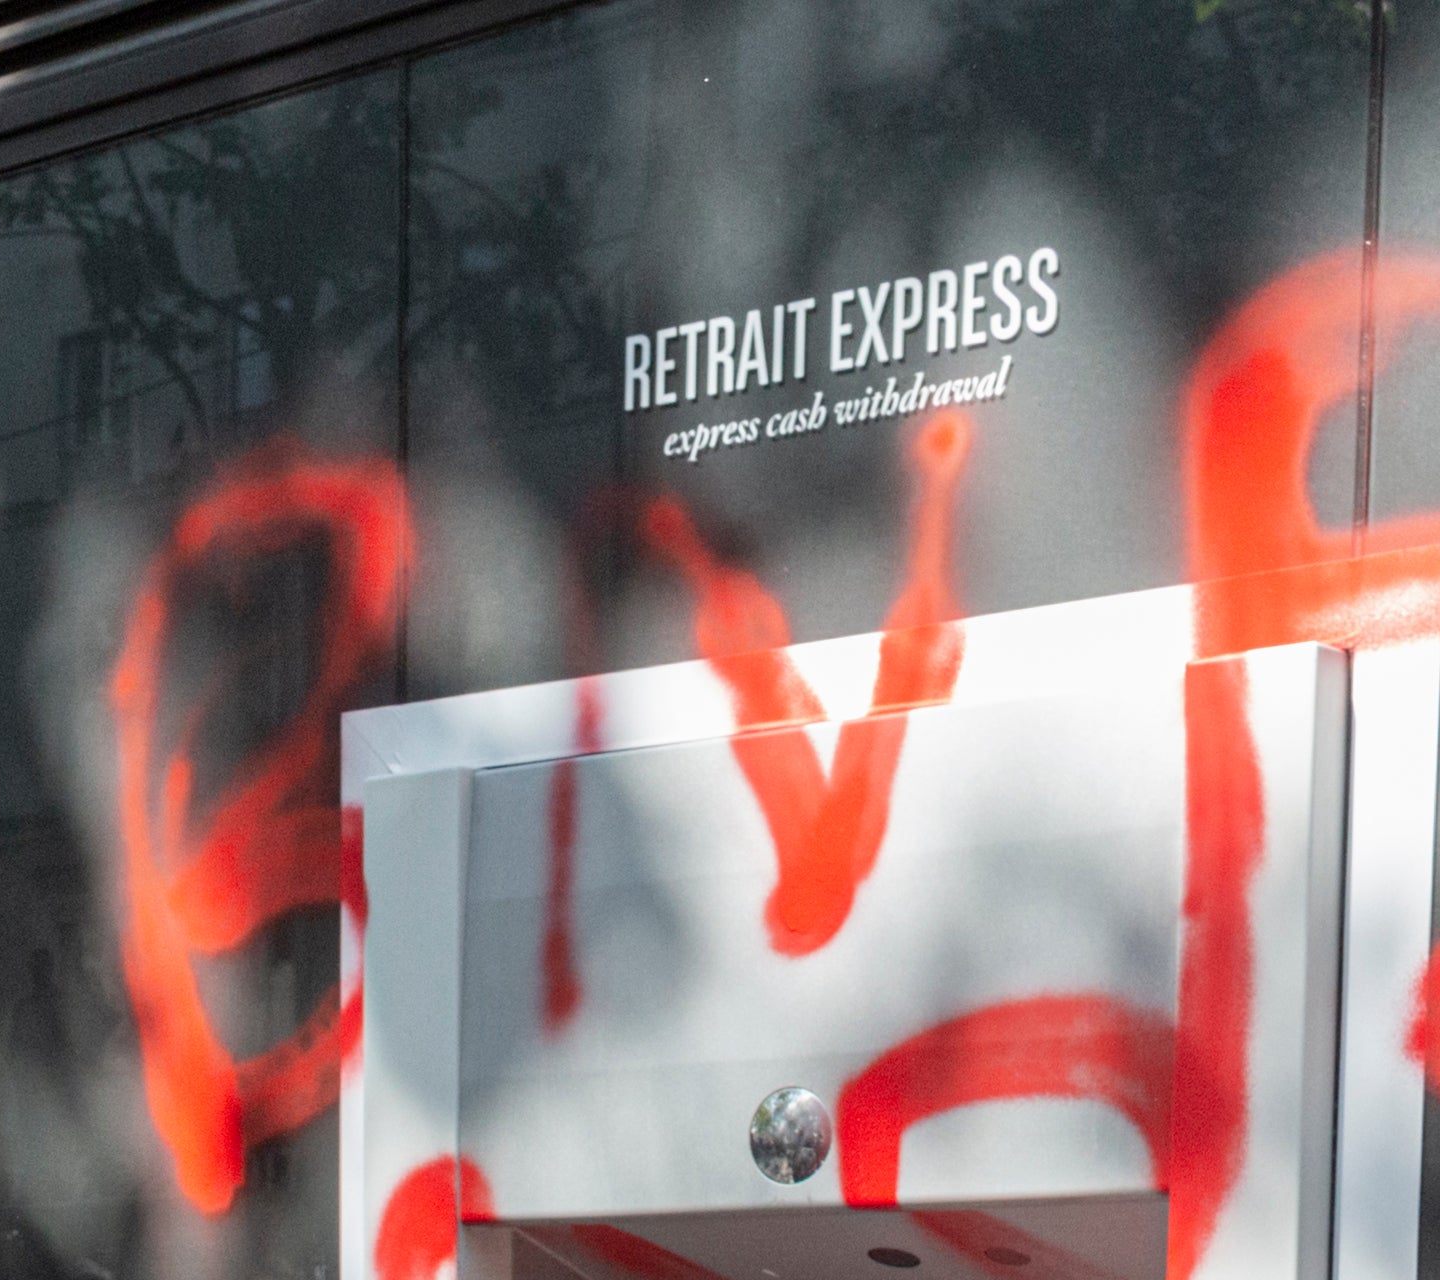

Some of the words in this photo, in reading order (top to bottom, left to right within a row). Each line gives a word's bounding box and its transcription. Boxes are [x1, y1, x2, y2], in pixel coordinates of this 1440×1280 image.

[623, 298, 817, 412] RETRAIT
[829, 246, 1060, 373] EXPRESS
[662, 414, 761, 462] express
[766, 391, 826, 438] cash
[833, 355, 1013, 426] withdrawal
